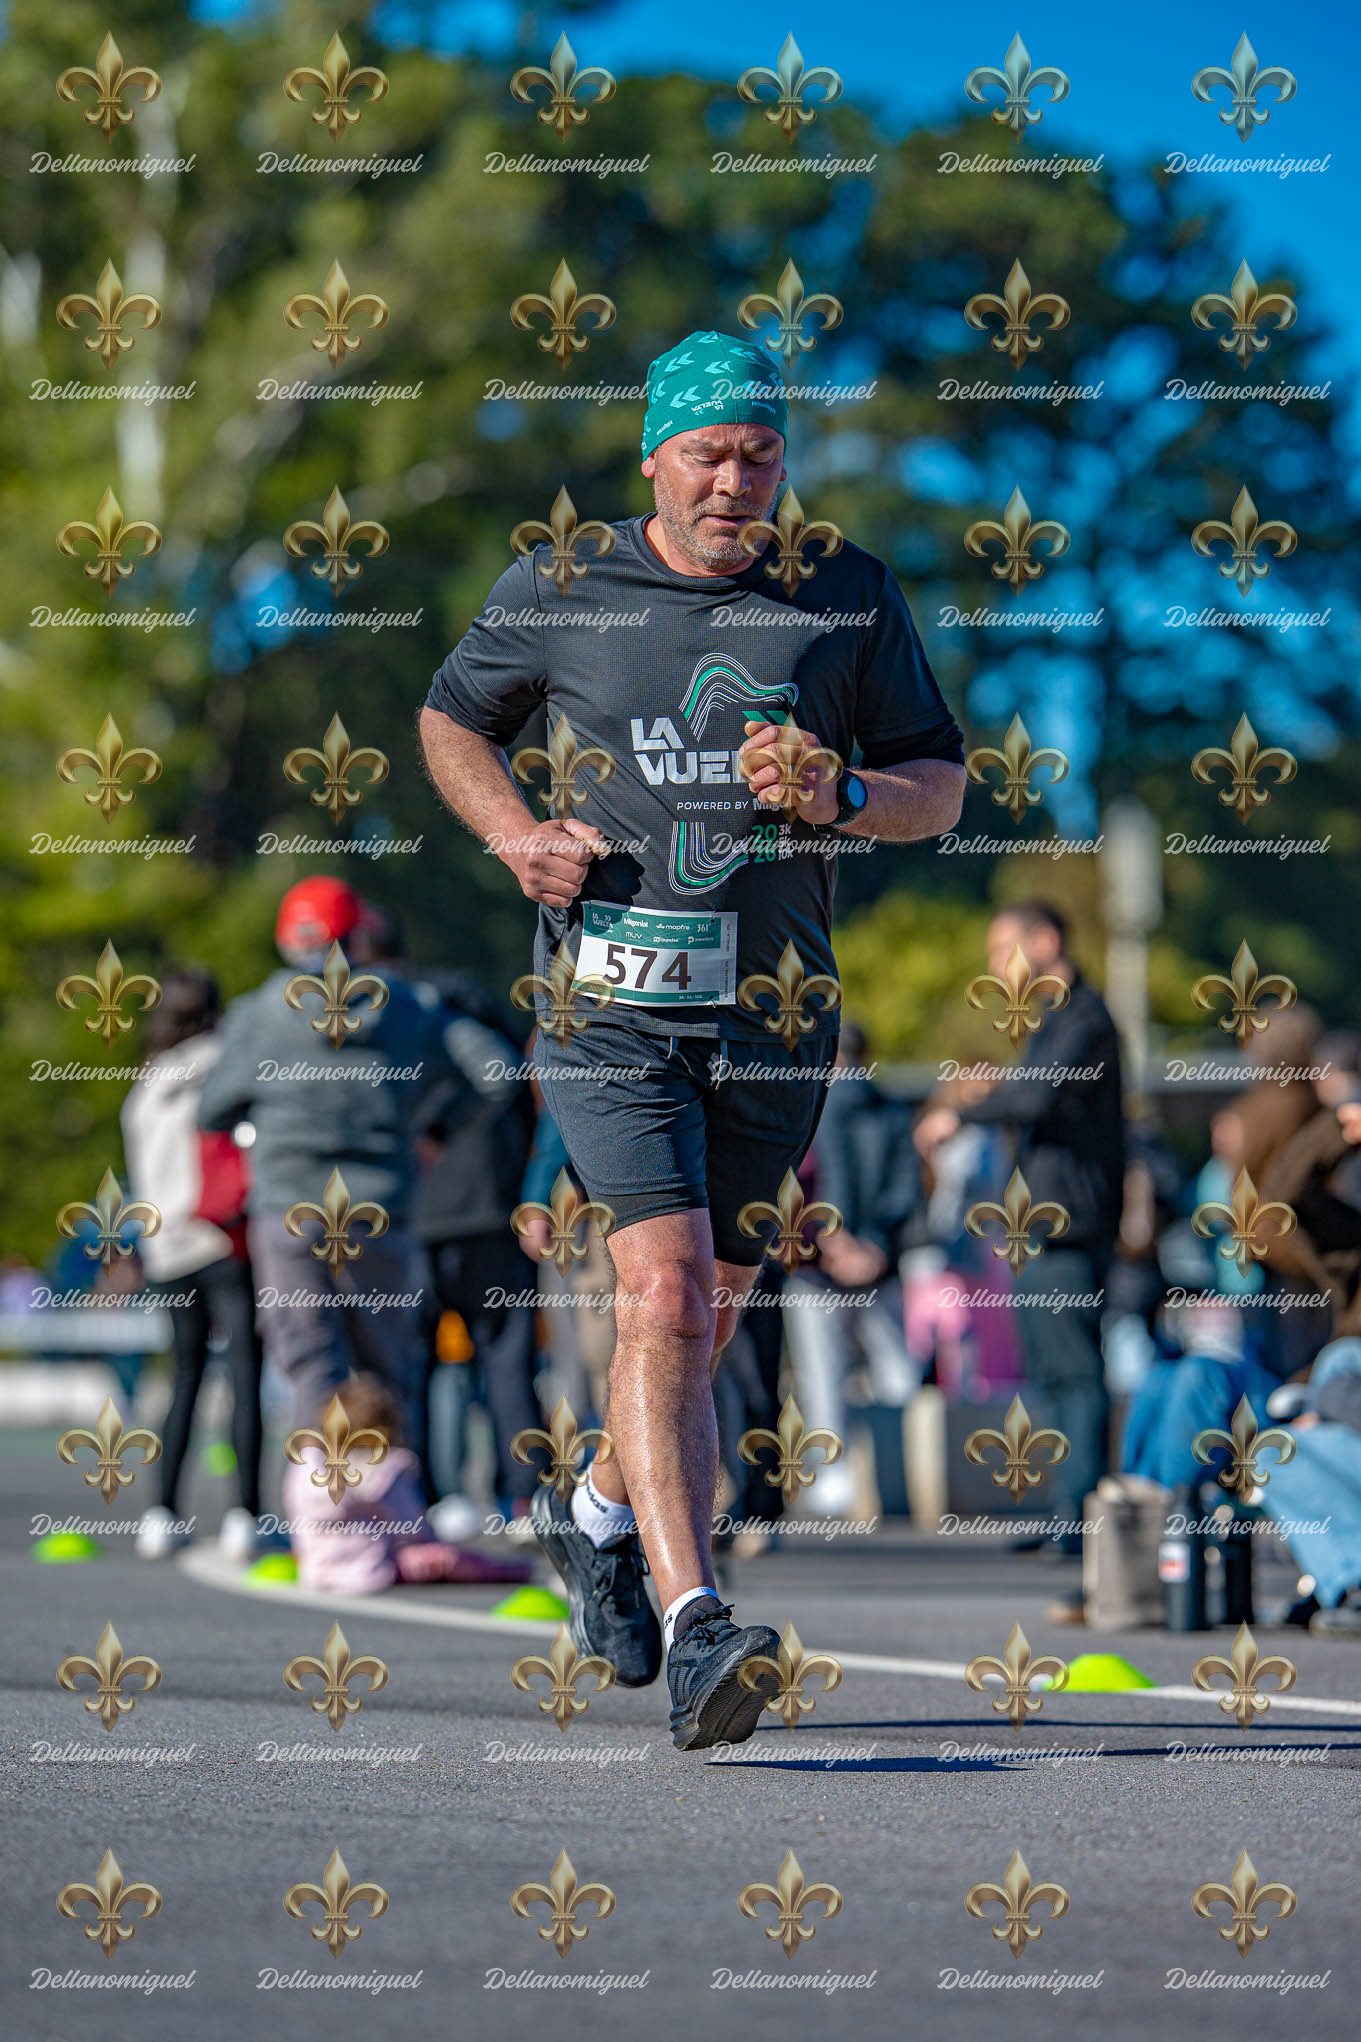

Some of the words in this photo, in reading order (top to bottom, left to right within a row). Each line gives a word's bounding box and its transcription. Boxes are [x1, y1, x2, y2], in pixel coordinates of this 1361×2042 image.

[630, 717, 685, 751] LA
[634, 751, 746, 785] VUEL
[676, 801, 731, 811] POWERED
[734, 800, 749, 810] BY
[602, 943, 692, 991] 574
